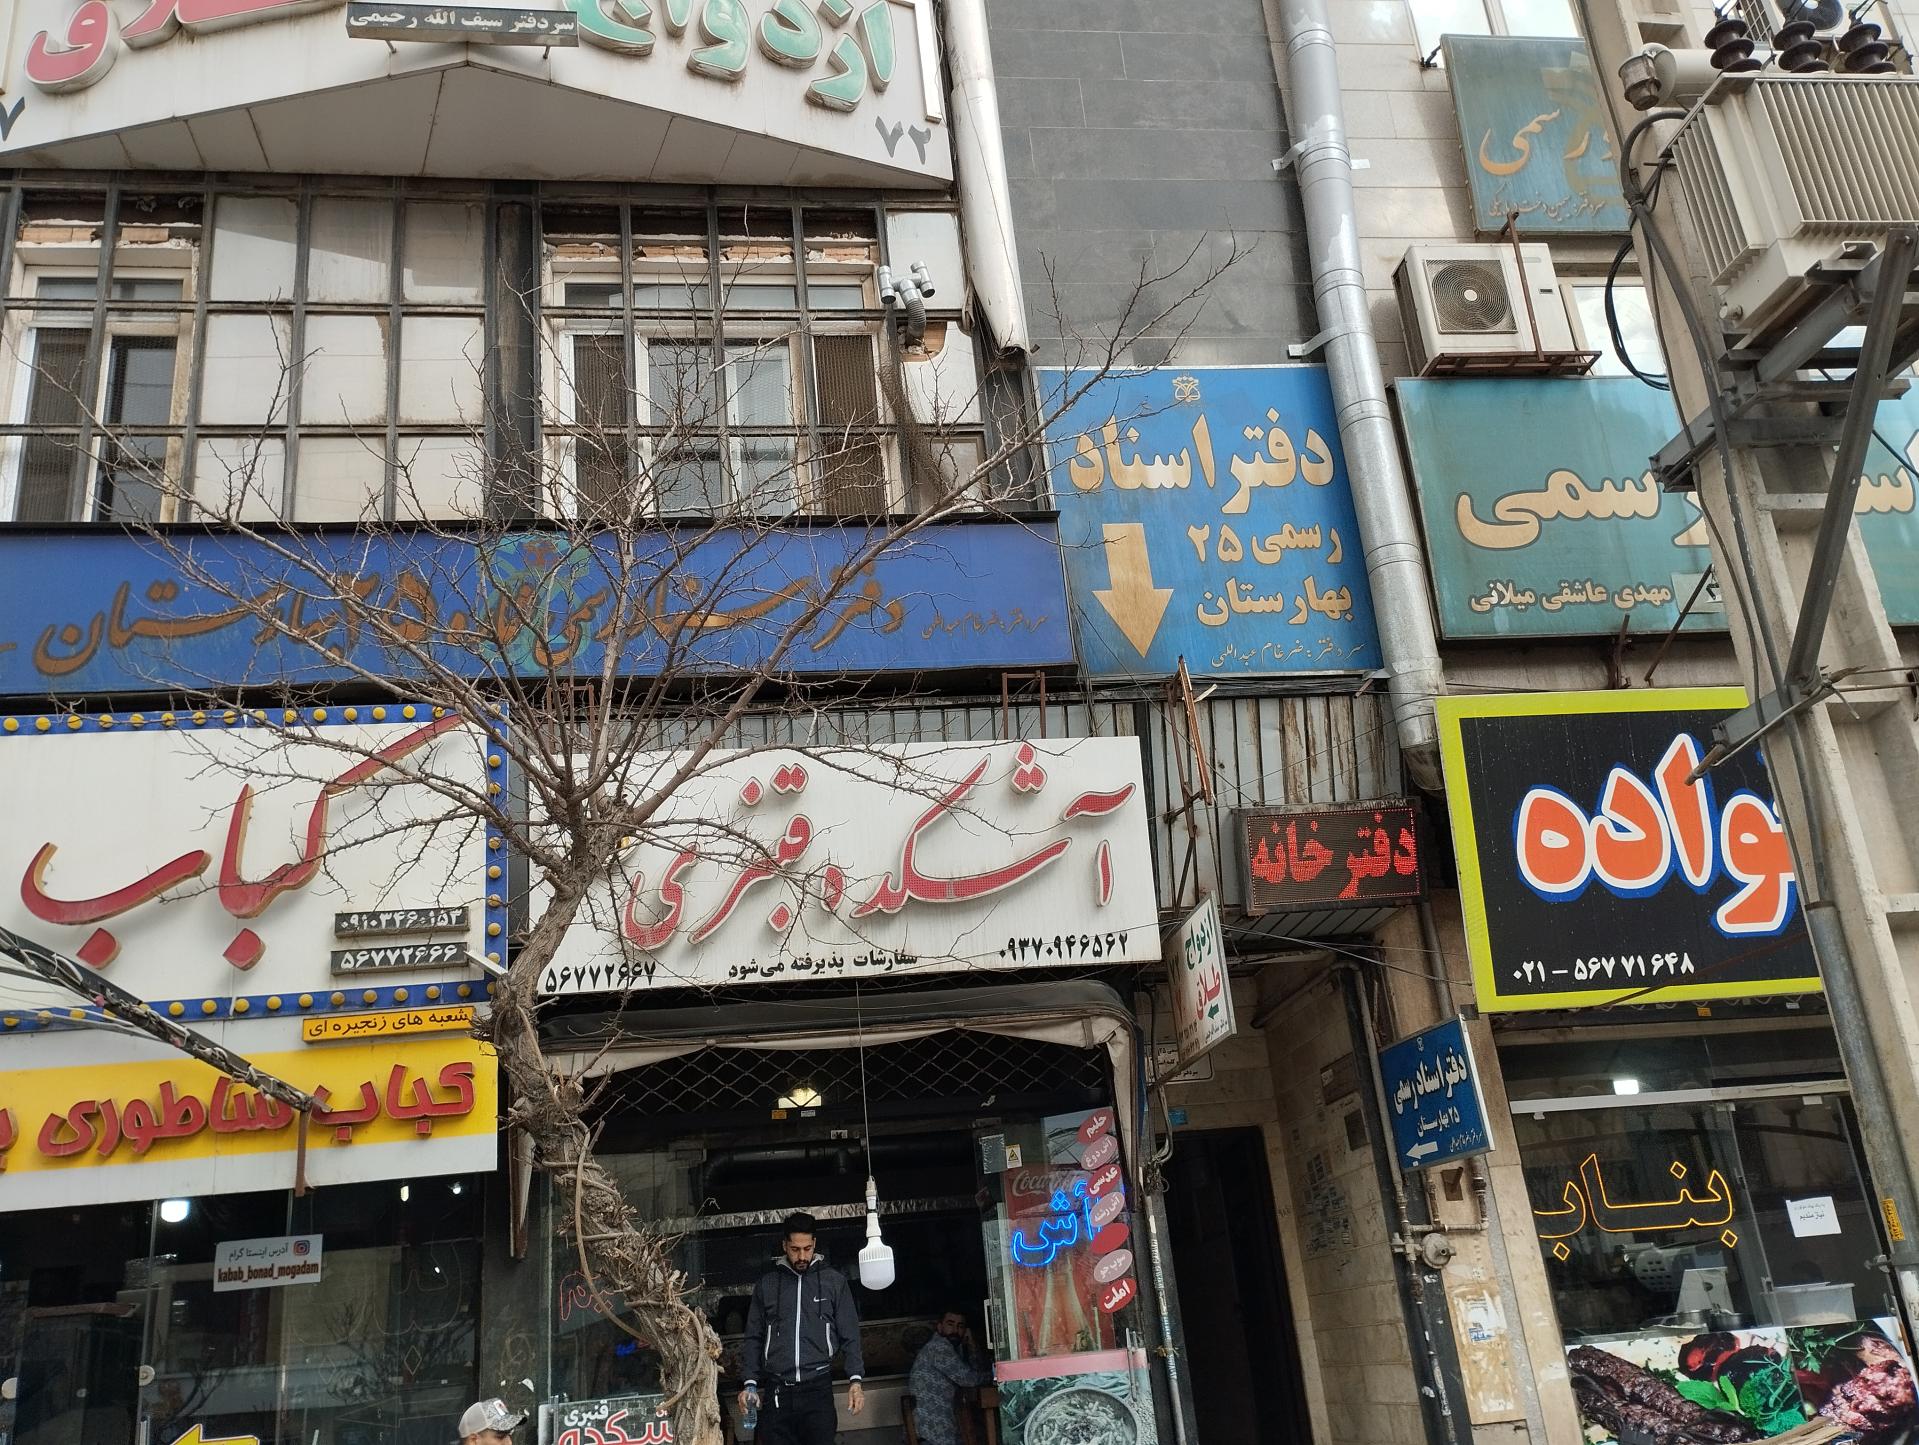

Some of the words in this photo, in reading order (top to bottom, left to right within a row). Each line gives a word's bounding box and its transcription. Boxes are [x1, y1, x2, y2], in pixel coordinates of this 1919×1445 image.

[349, 9, 418, 28] رحیمی
[424, 8, 456, 25] الله
[461, 12, 503, 30] سیف
[508, 12, 575, 33] سردفتر
[875, 116, 932, 165] ۷۲
[1069, 412, 1217, 492] اسناد
[1221, 407, 1335, 514] دفتر
[1186, 523, 1244, 564] ۲۵
[1251, 522, 1344, 565] رسمی
[1197, 575, 1354, 627] بهارستان
[1471, 581, 1537, 612] میلانی
[1542, 580, 1608, 610] عاشقی
[1613, 584, 1672, 609] مهدی
[20, 713, 468, 972] کباب
[818, 741, 1138, 920] آشکده
[622, 760, 818, 951] قنبری
[1251, 819, 1334, 884] خانه
[1338, 812, 1418, 898] دفتر
[999, 932, 1128, 962] ۰۹۳۷۰۹۴۶۵۶۲
[1184, 908, 1214, 970] ازدواج
[340, 944, 458, 970] ۵۶۷۷۲۶۶۶
[790, 952, 845, 975] پذیرفته
[545, 960, 657, 993] ۵۶۷۷۲۶۶۷
[1196, 963, 1221, 1021] طلاق
[308, 1019, 328, 1038] ای
[332, 1016, 387, 1035] زنجیره
[392, 1012, 423, 1030] های
[428, 1008, 470, 1027] شعبه
[1416, 1053, 1445, 1095] اسناد
[1445, 1046, 1467, 1098] دفتر
[309, 1061, 476, 1142] کباب
[1393, 1078, 1419, 1114] رسمی
[37, 1076, 294, 1158] ساطوری
[1086, 1114, 1107, 1138] حلیم
[1417, 1109, 1449, 1138] بهارستان
[1448, 1105, 1460, 1125] ۲۵
[1089, 1166, 1118, 1195] عدسی
[1533, 1153, 1738, 1261] بناب
[228, 1247, 245, 1261] گرام
[268, 1242, 289, 1257] آدرس
[1104, 1280, 1131, 1309] املت
[564, 1400, 609, 1426] قنبری
